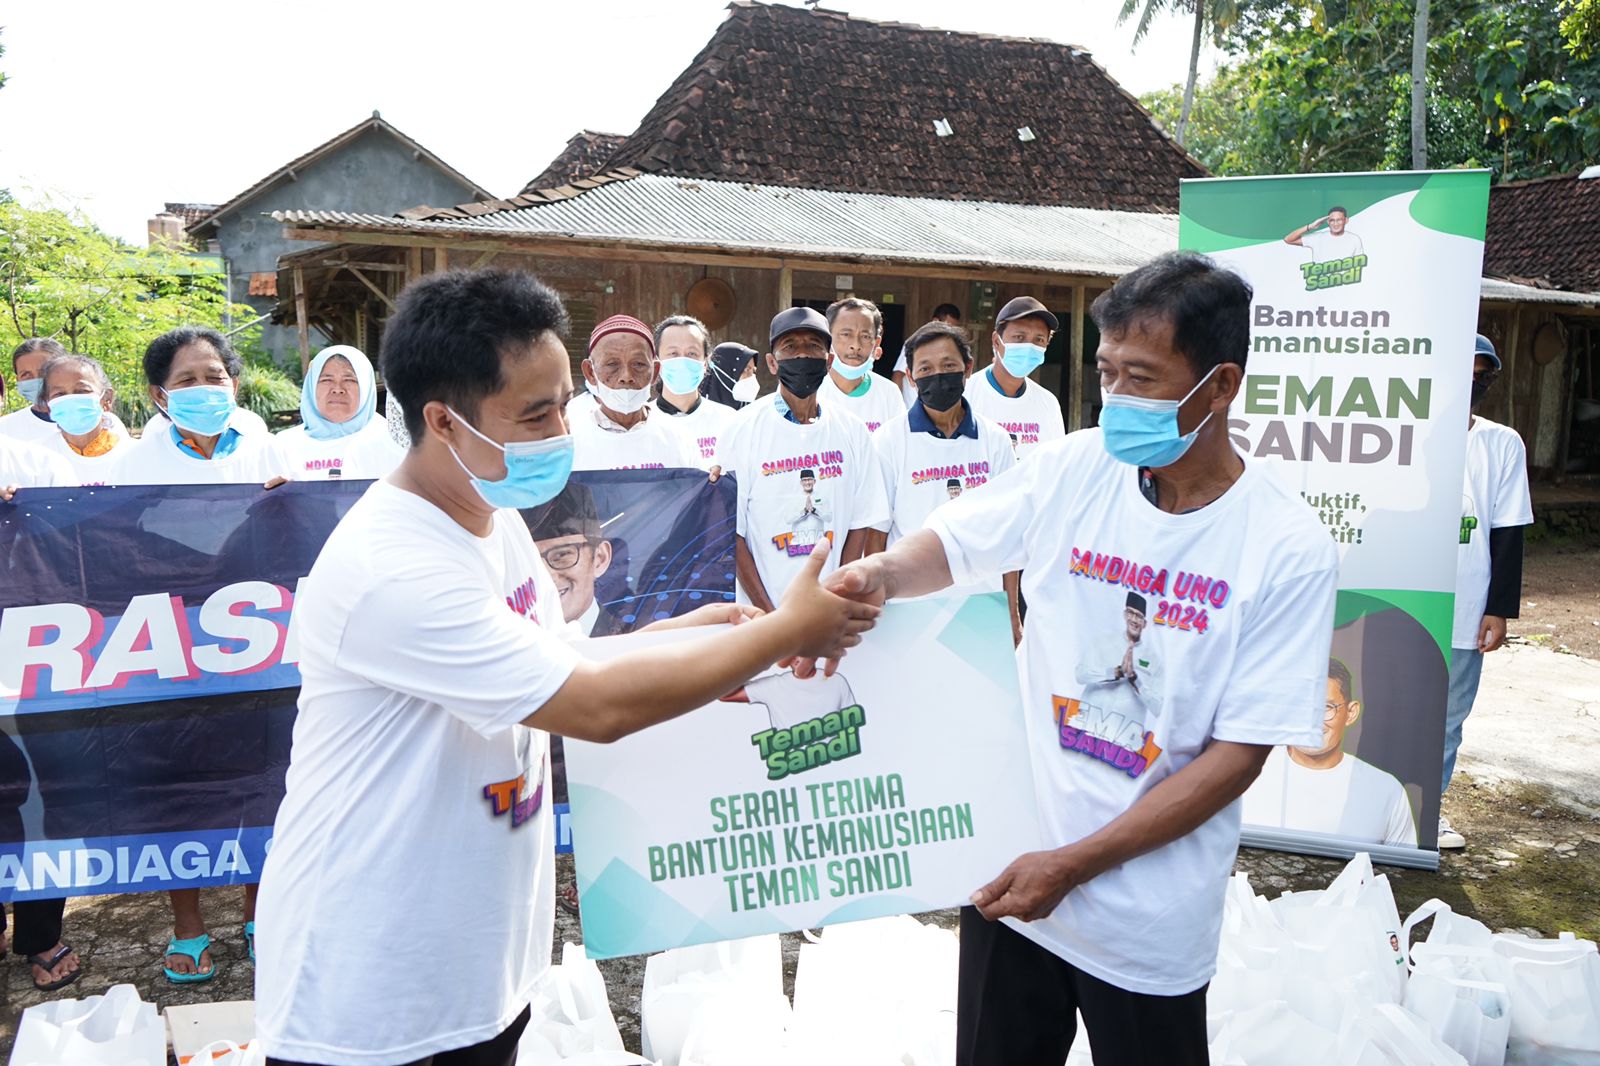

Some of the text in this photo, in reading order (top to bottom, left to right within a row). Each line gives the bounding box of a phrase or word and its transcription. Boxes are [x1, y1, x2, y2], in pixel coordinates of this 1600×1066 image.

[1300, 253, 1368, 280] Teman
[1305, 266, 1362, 291] Sandi
[1254, 304, 1390, 328] Bantuan
[1249, 329, 1432, 355] manusiaan
[762, 449, 844, 477] SANDIAGA UNO
[819, 465, 843, 481] 2024
[912, 460, 990, 485] SANDIAGA UNO
[1069, 547, 1233, 609] SANDIAGA UNO
[1153, 600, 1210, 634] 2024
[751, 704, 866, 760] Teman
[767, 727, 862, 781] Sandi
[1059, 724, 1148, 779] SANDI
[710, 773, 905, 833] SERAH TERIMA
[648, 803, 975, 882] BANTUAN KEMANUSIAAN
[723, 851, 912, 913] TEMAN SANDI
